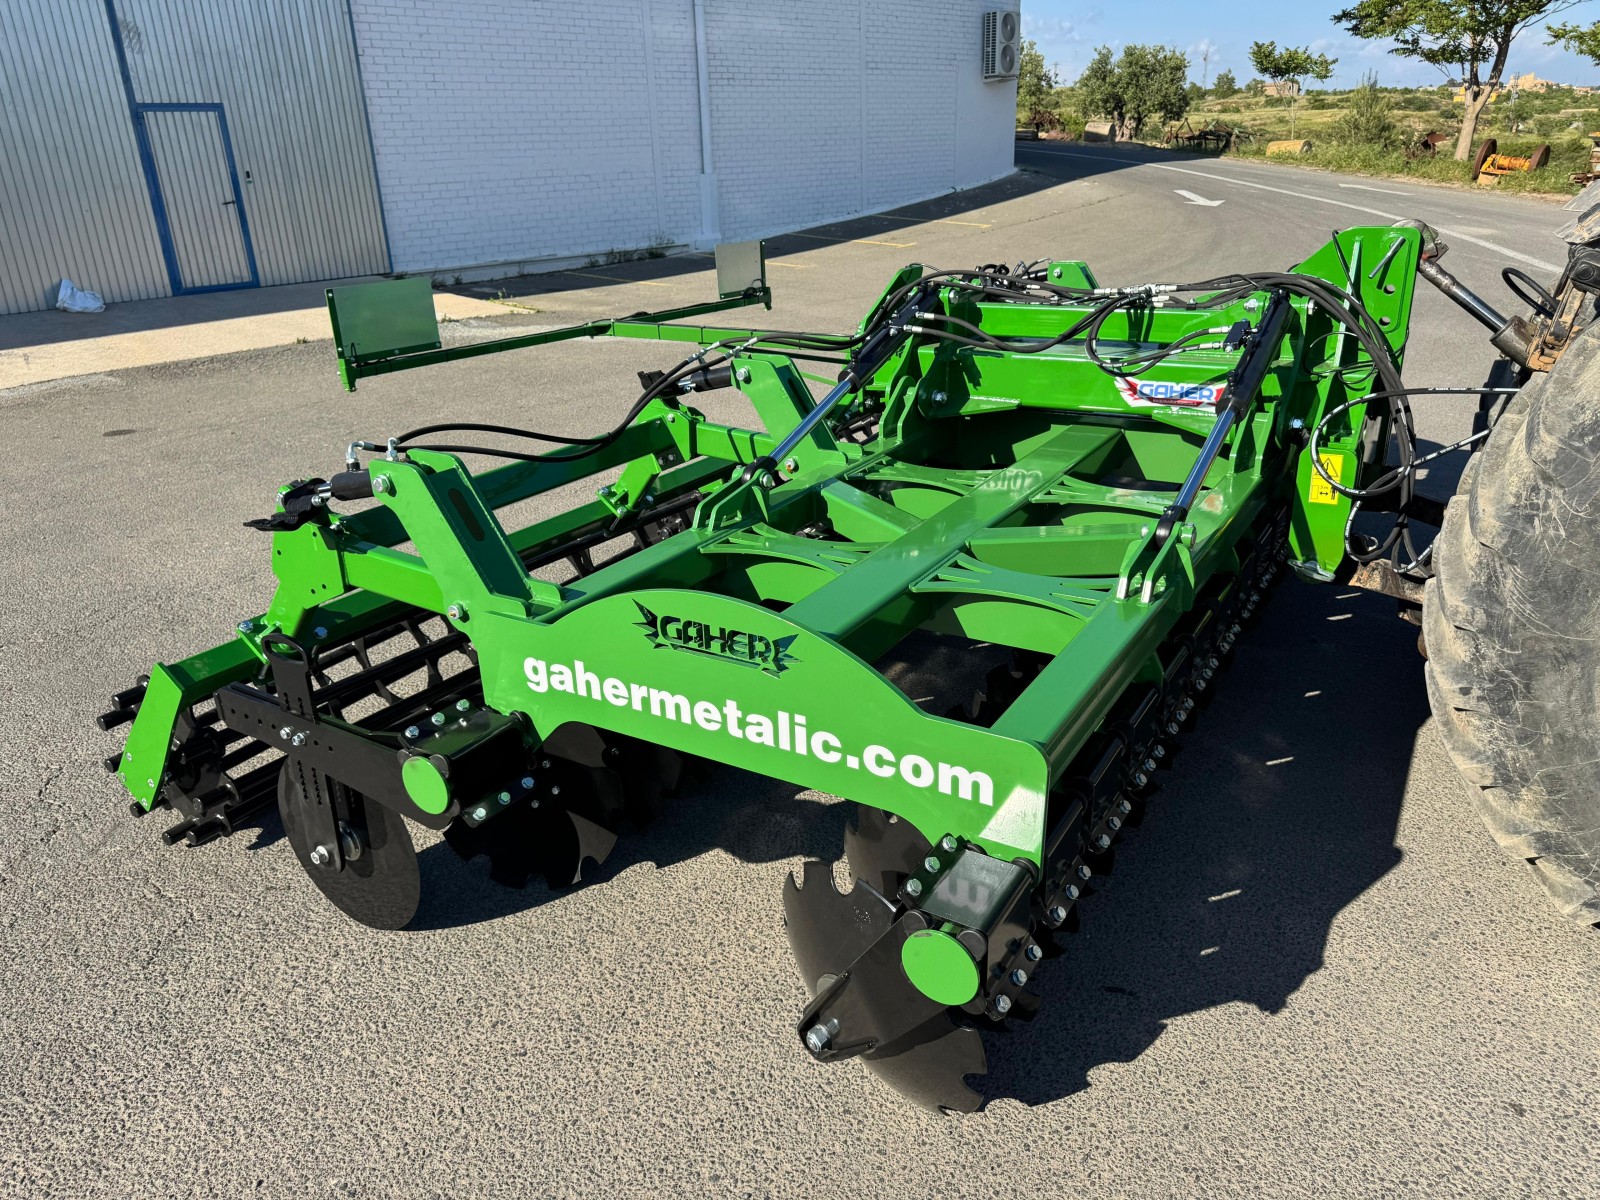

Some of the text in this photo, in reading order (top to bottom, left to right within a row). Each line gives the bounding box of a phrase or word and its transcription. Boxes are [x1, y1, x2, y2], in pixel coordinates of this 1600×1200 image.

[1139, 383, 1214, 401] GAHER
[660, 615, 771, 664] GAHER
[524, 657, 994, 806] gahermetalic.com
